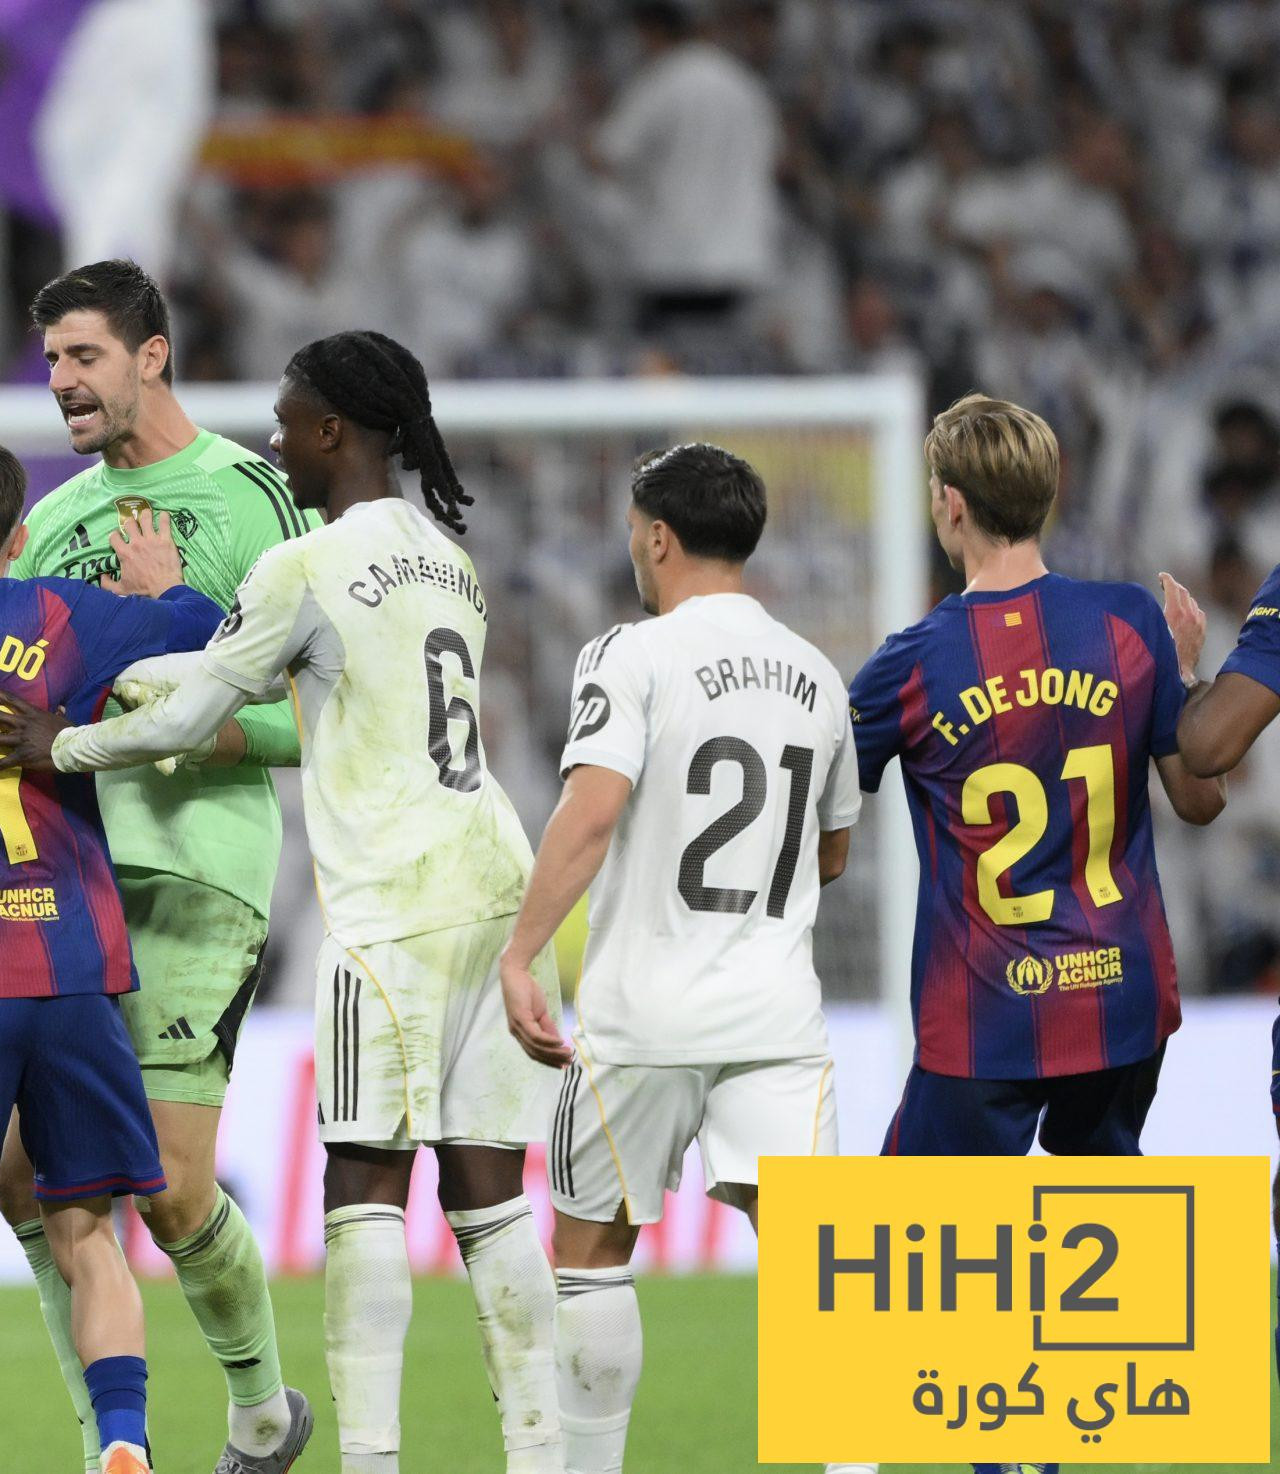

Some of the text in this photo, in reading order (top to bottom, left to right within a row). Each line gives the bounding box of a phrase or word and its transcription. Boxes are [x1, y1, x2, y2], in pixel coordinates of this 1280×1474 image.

[348, 553, 488, 621] CAMAVING
[424, 627, 482, 793] 6
[695, 656, 817, 713] BRAHIM
[932, 668, 1118, 746] F. DE JONG
[677, 735, 814, 919] 21
[961, 743, 1123, 926] 21
[1055, 947, 1121, 970] UNHCR
[1058, 961, 1122, 986] ACNUR
